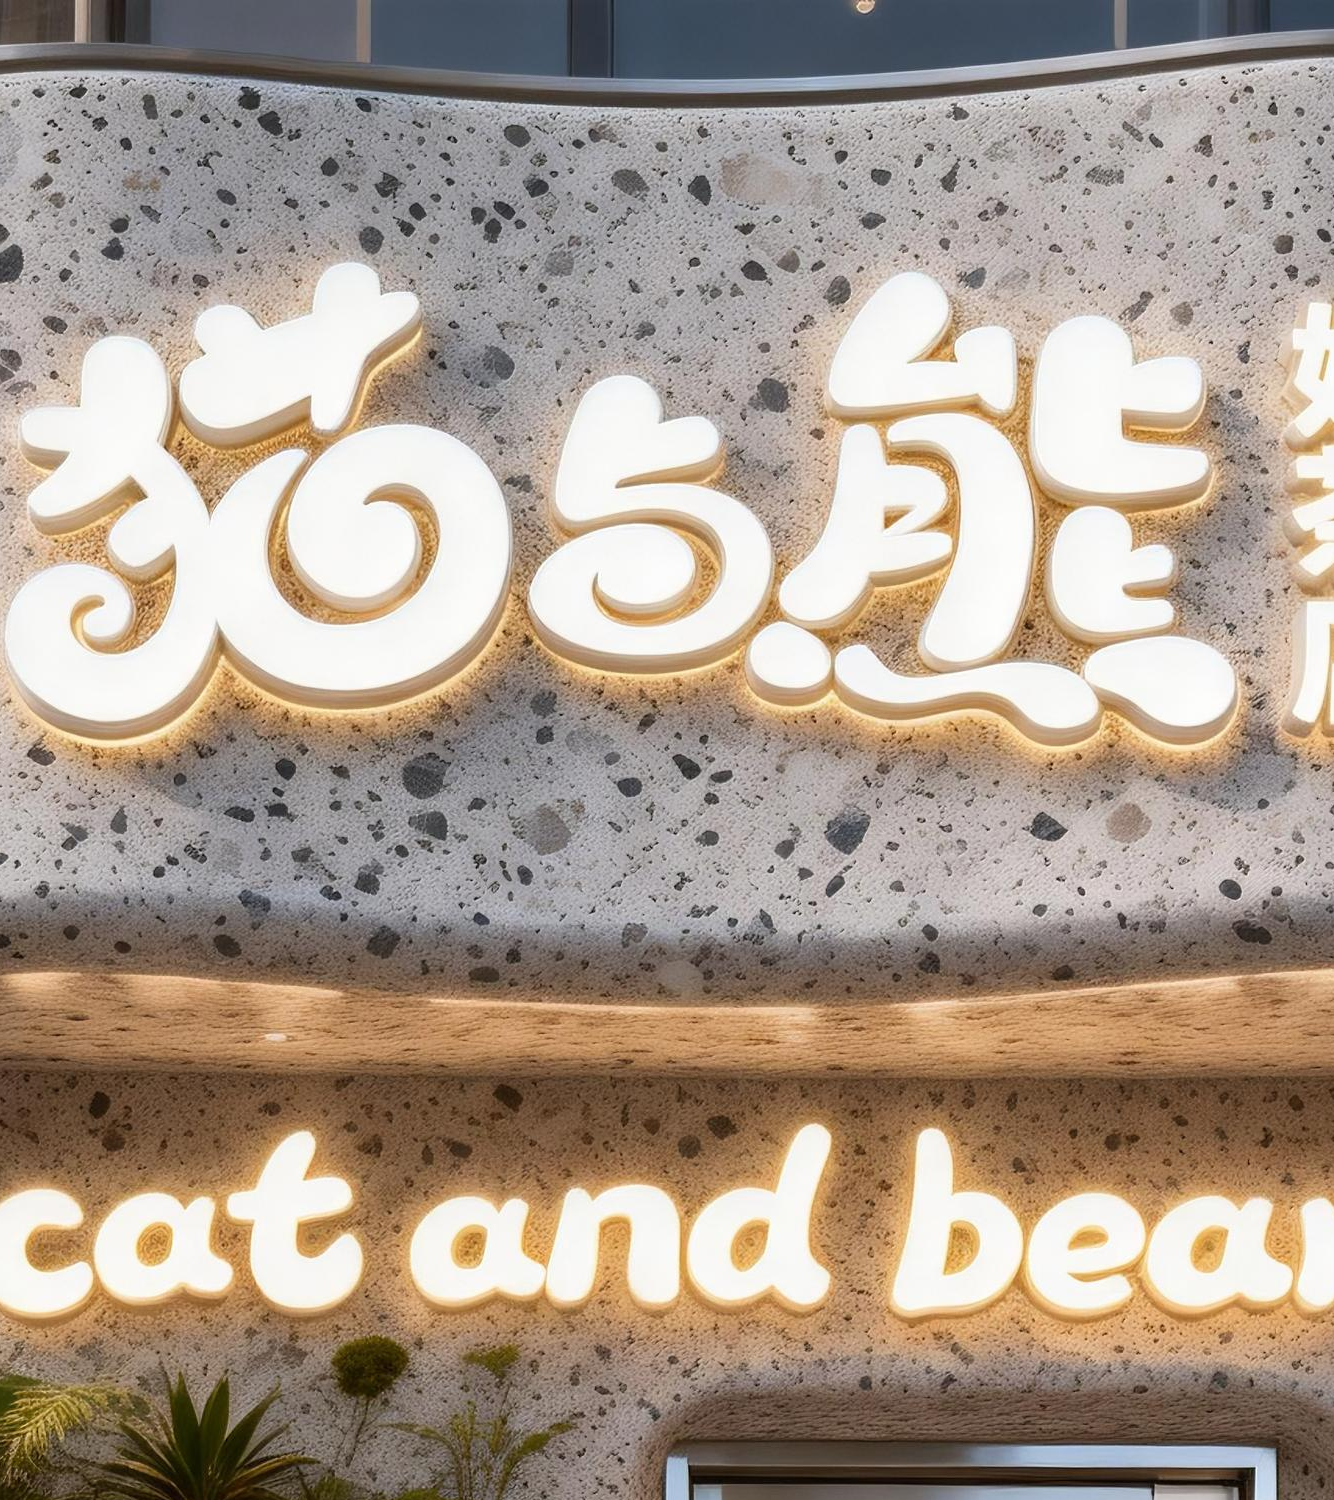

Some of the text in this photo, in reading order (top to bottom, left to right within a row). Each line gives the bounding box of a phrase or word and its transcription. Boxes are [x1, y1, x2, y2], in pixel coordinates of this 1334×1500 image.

[3, 260, 1240, 746] 猫与熊
[408, 1123, 831, 1312] and
